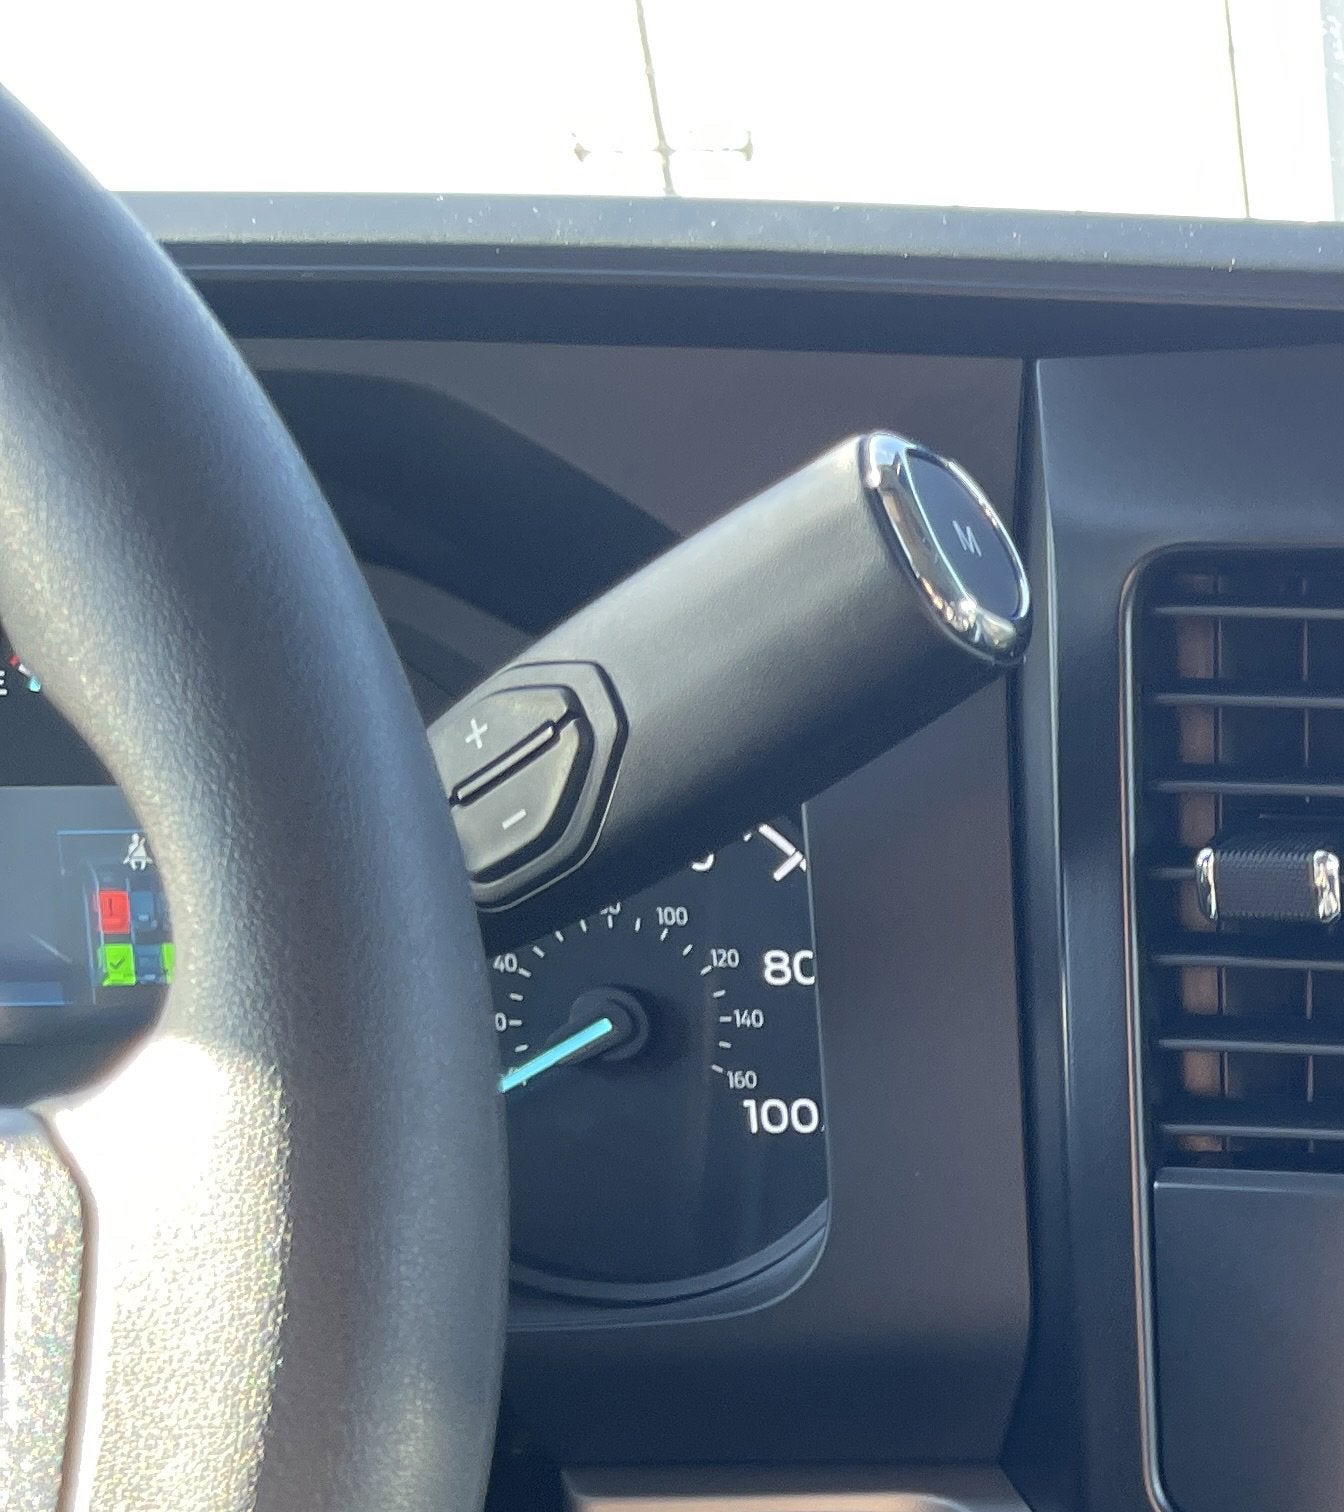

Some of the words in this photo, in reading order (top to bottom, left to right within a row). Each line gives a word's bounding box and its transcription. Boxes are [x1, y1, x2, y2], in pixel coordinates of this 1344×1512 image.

[952, 518, 984, 557] M
[656, 906, 689, 926] 100
[493, 952, 519, 973] 40
[710, 948, 740, 968] 120
[733, 1008, 765, 1028] 140
[726, 1069, 758, 1090] 160
[742, 1097, 819, 1134] 100
